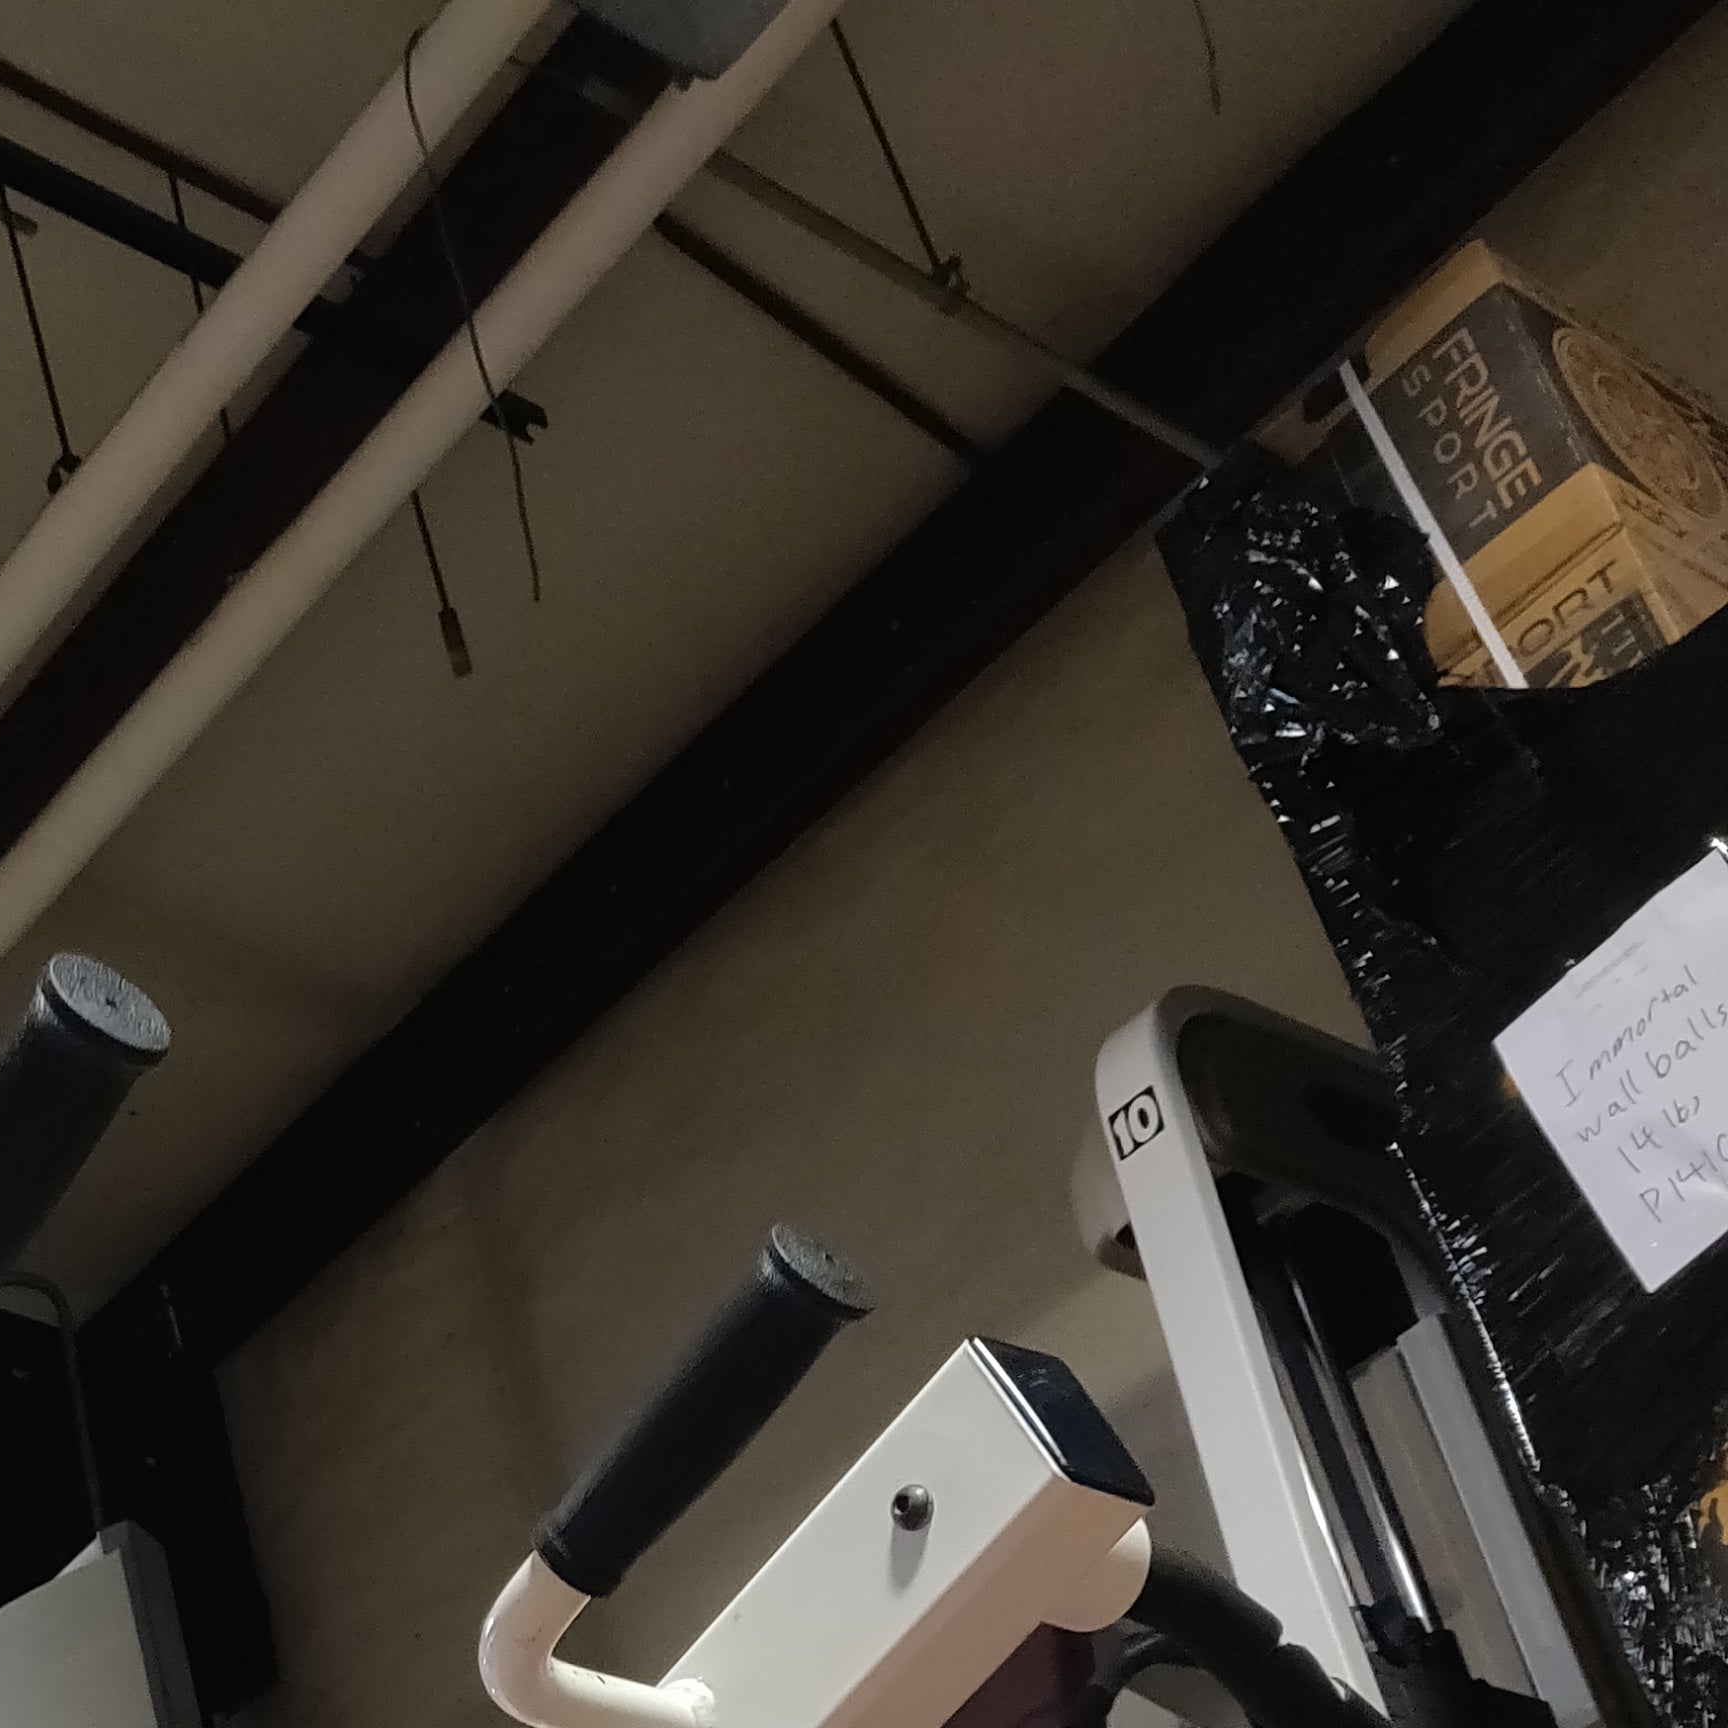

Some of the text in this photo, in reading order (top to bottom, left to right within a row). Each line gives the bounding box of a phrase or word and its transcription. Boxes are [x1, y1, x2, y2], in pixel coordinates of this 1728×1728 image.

[1402, 364, 1498, 528] SPORT
[1432, 327, 1541, 510] FRINGE
[1555, 965, 1698, 1107] Immortal
[1575, 1003, 1727, 1142] wall balls
[1111, 1090, 1160, 1156] 10
[1617, 1126, 1663, 1173] 14
